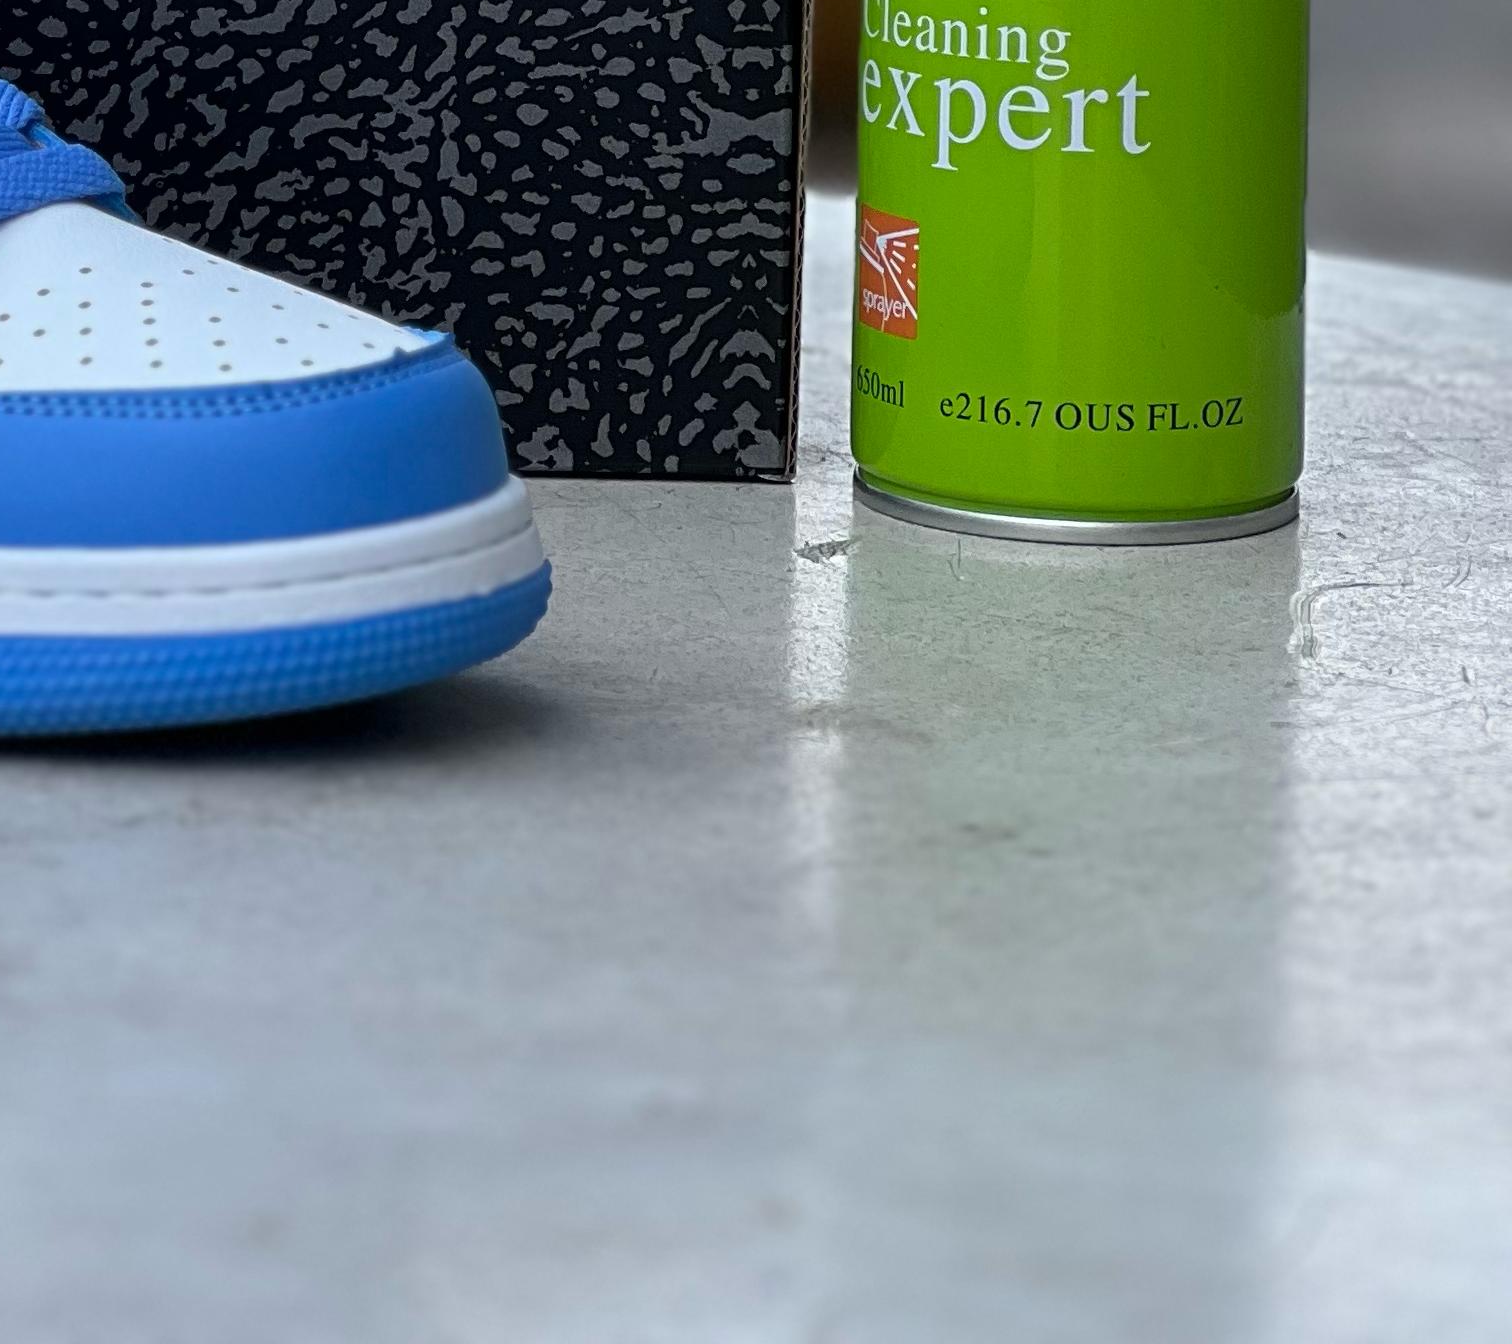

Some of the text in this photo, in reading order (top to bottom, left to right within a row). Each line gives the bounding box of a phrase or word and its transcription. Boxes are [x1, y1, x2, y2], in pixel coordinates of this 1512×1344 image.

[861, 55, 1152, 171] expert
[863, 288, 908, 321] sprayer
[856, 364, 905, 408] 650ml
[939, 392, 1244, 432] e216.7 OUS FL.OZ
